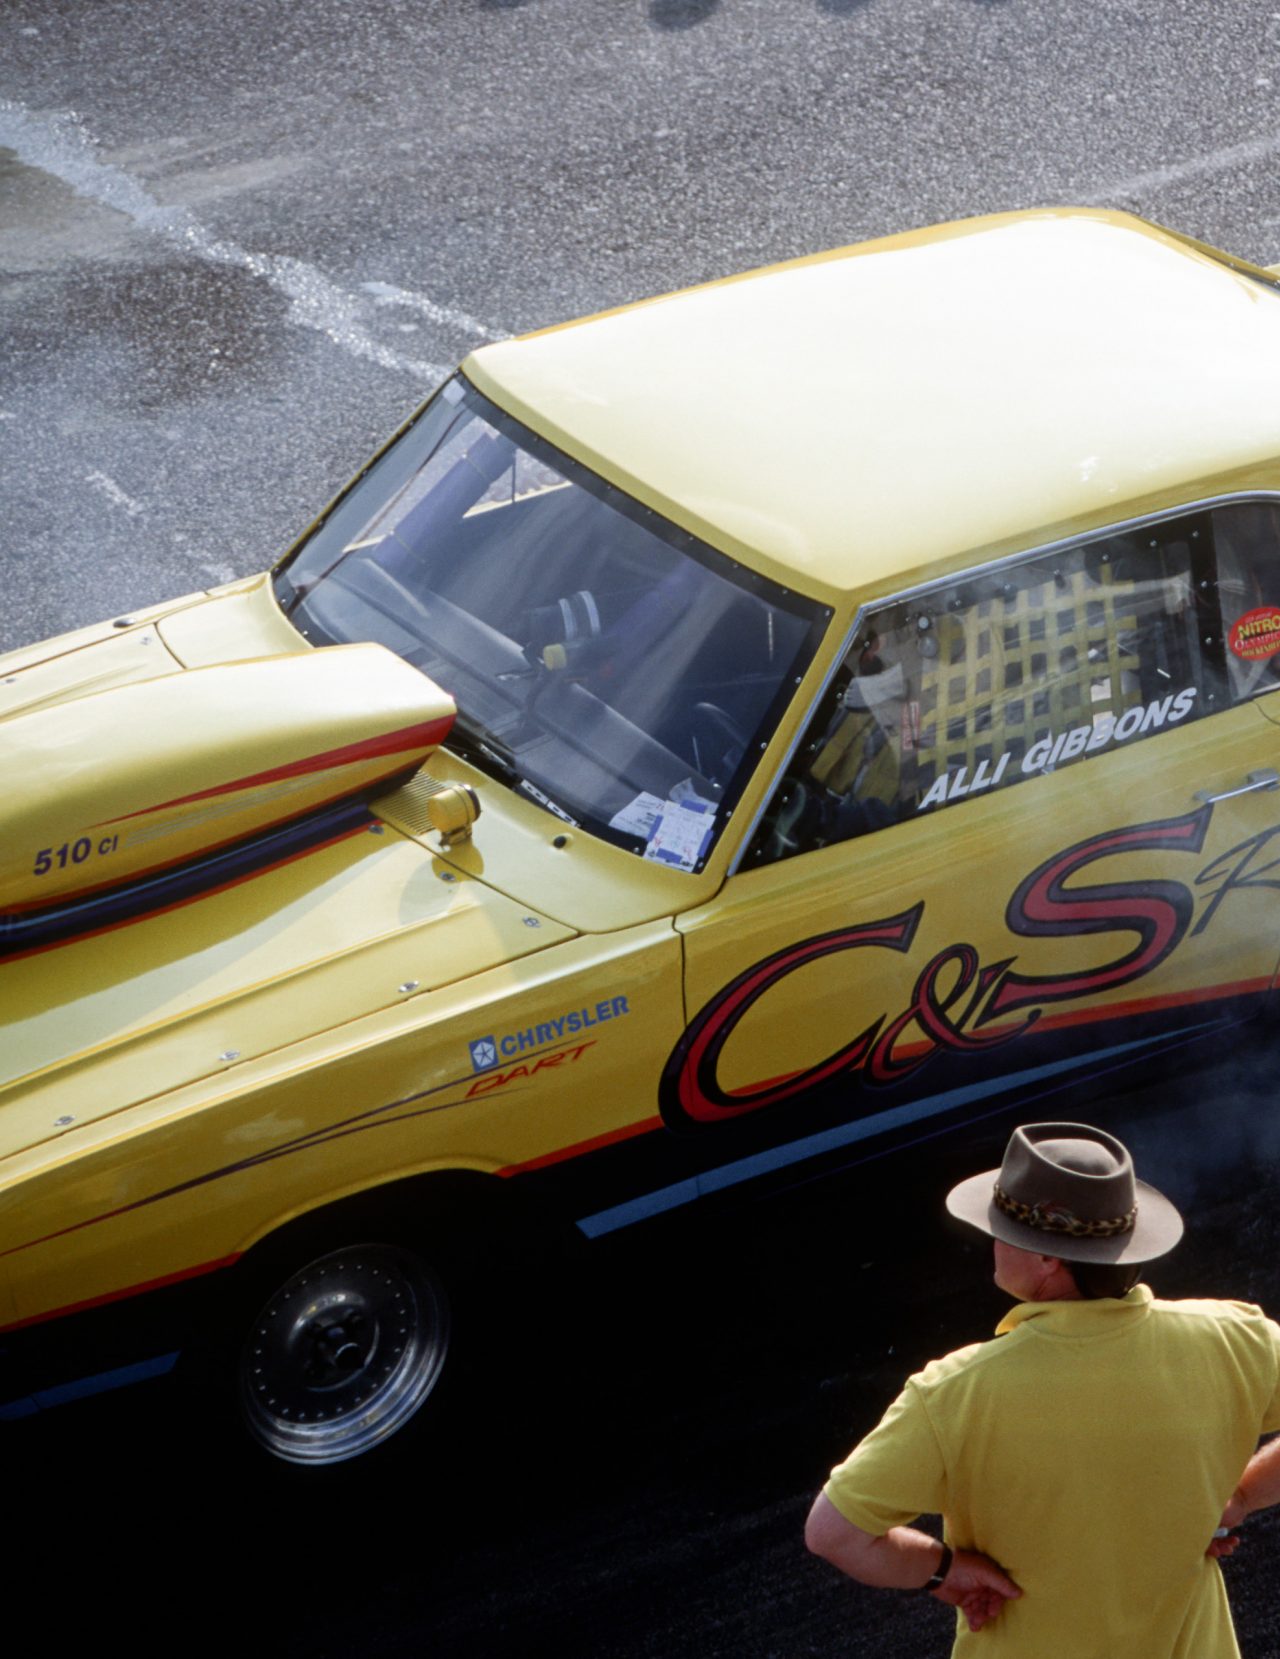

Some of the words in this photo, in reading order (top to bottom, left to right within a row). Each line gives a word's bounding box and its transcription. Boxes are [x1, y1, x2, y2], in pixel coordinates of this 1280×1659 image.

[918, 752, 1010, 809] ALLI
[1021, 687, 1197, 773] GIBBONS
[33, 836, 92, 876] 510
[98, 834, 119, 855] CI
[658, 804, 1216, 1136] C&S
[500, 995, 630, 1056] CHRYSLER
[465, 1040, 598, 1098] DART
